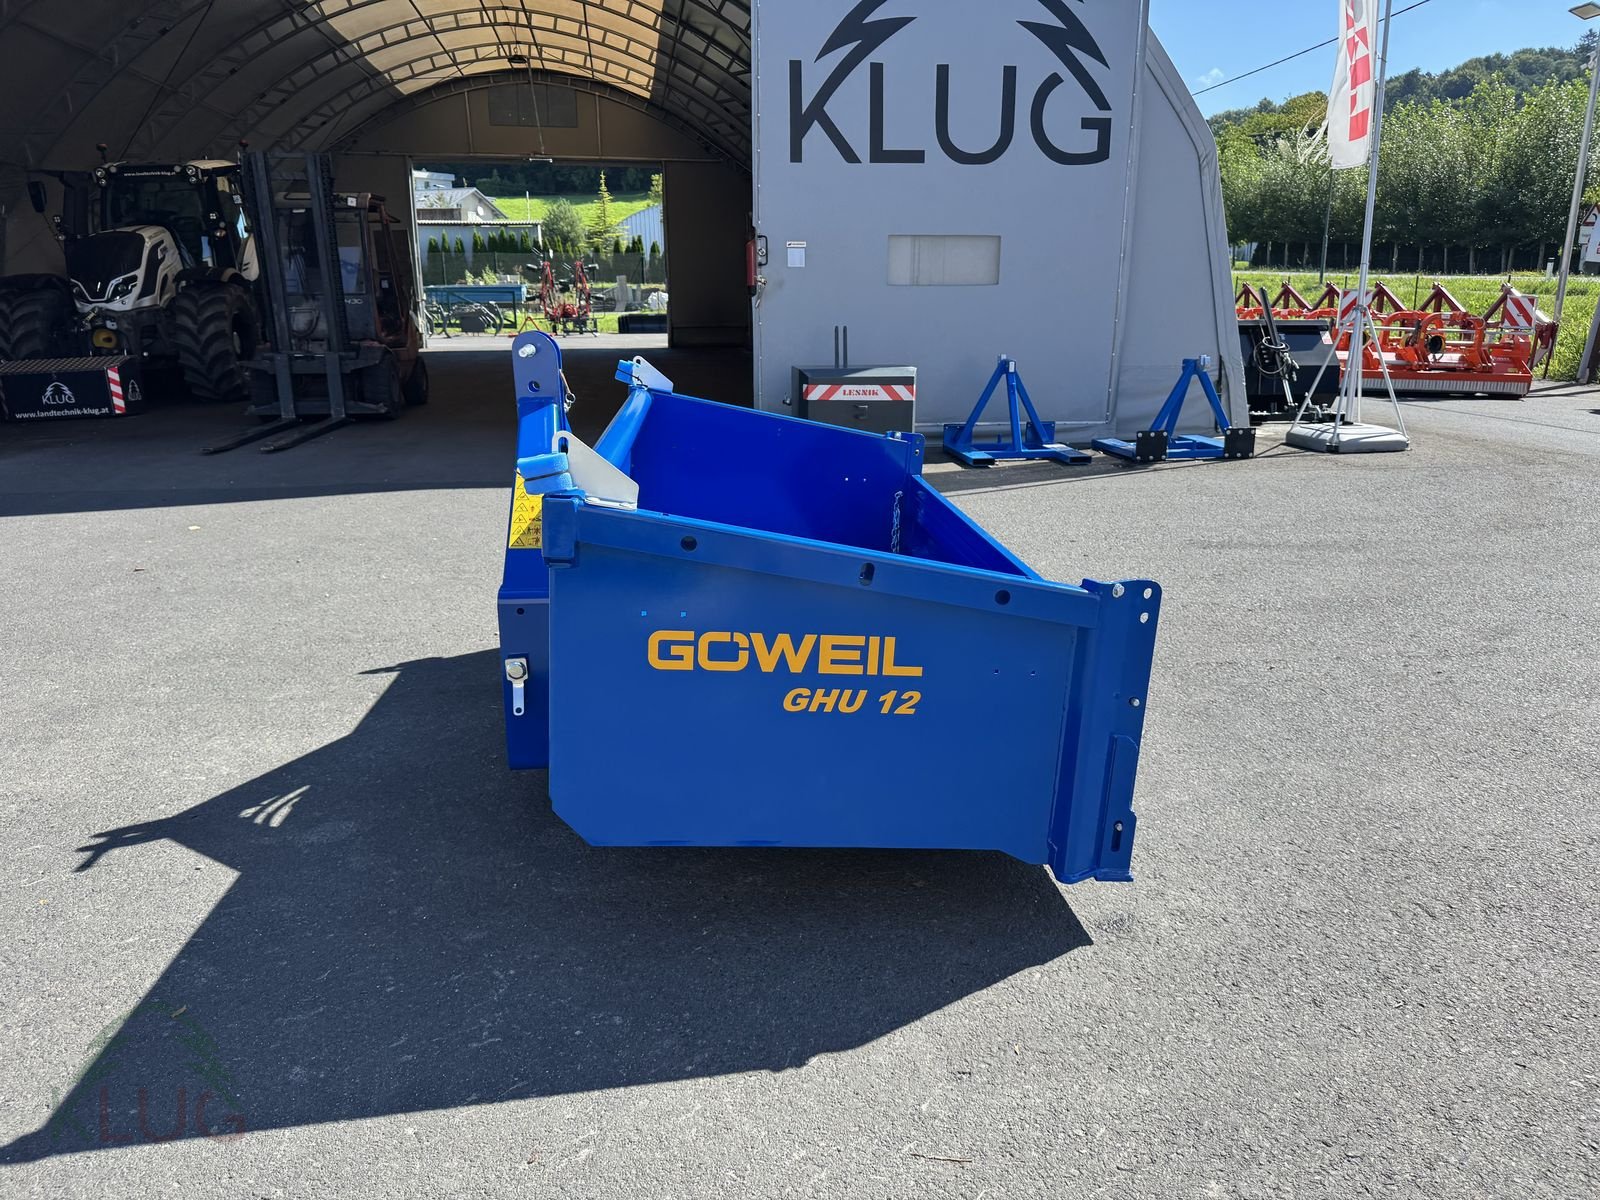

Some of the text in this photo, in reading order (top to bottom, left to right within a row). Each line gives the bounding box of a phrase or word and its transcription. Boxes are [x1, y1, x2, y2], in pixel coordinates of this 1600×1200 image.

[789, 60, 1112, 165] KLUG
[42, 394, 76, 405] KLUG
[15, 407, 110, 419] www.landtechnik-klug.at
[783, 687, 922, 715] GHU 12
